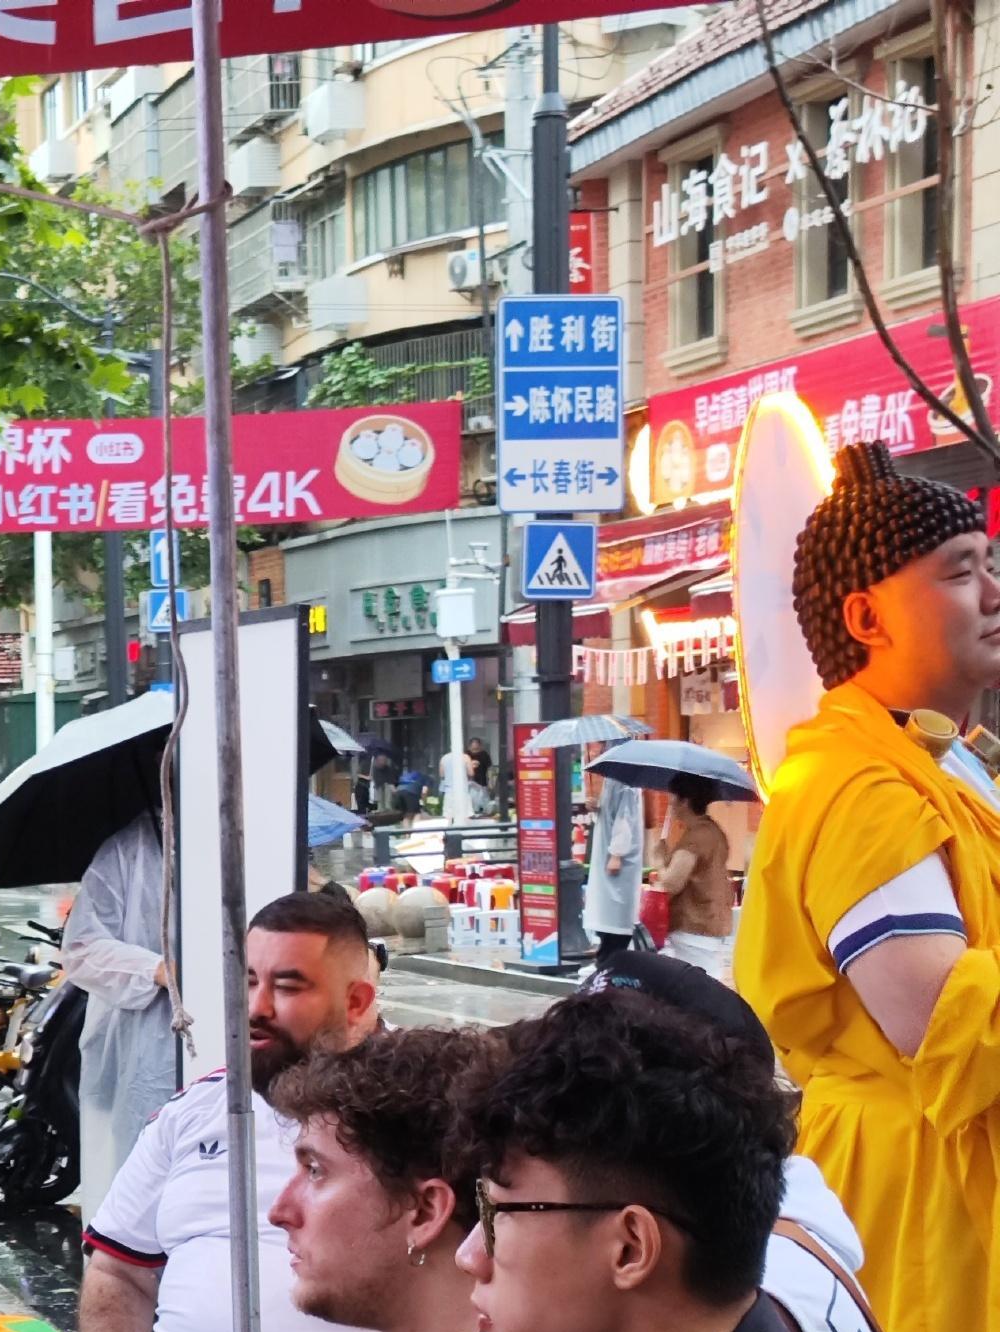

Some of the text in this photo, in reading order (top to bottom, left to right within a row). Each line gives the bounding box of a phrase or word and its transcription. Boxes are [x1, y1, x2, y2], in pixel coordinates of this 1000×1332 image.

[528, 315, 617, 353] 胜利街
[528, 386, 617, 425] 陈怀民路
[529, 459, 595, 495] 长春街
